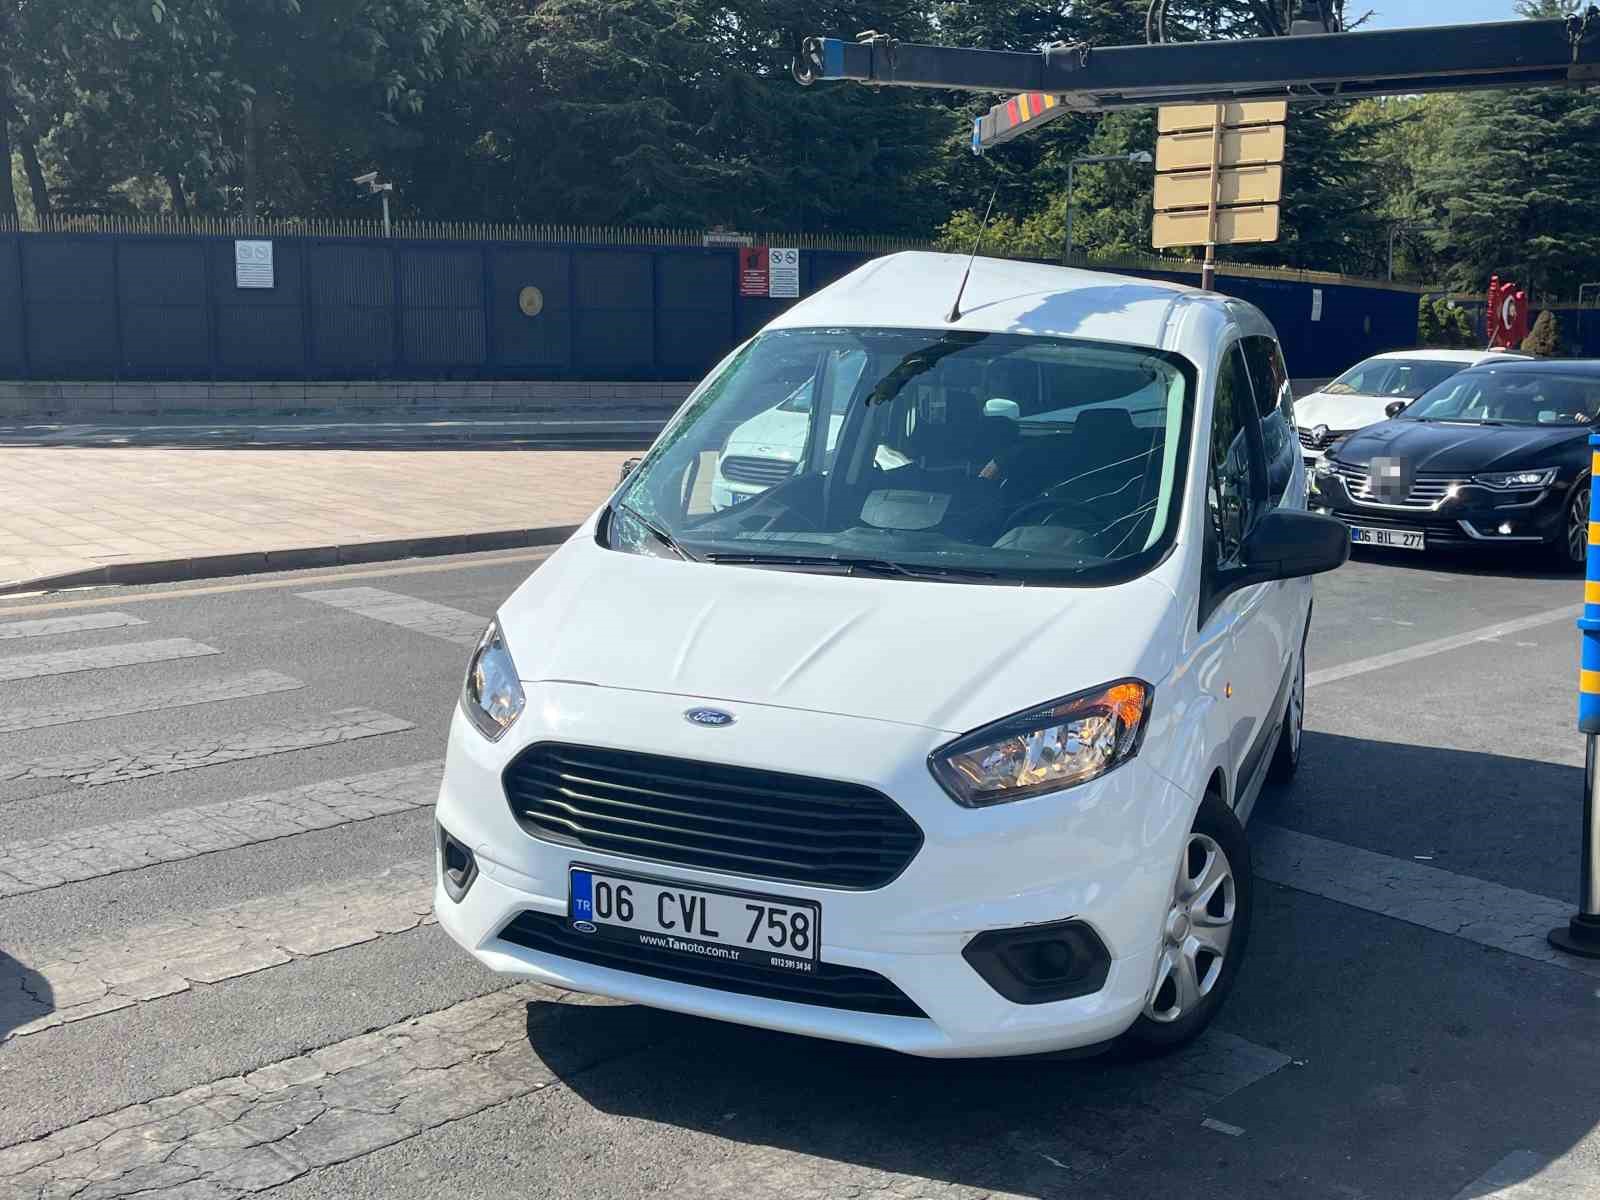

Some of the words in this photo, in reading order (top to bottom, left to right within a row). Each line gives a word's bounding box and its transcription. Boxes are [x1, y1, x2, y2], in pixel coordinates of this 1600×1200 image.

[1359, 529, 1371, 542] 06
[1403, 534, 1421, 547] 277
[575, 898, 591, 911] TR
[595, 881, 634, 922] 06
[657, 891, 719, 938] CVL
[745, 904, 809, 951] 758
[640, 934, 739, 959] www.Tanoto.com.tr
